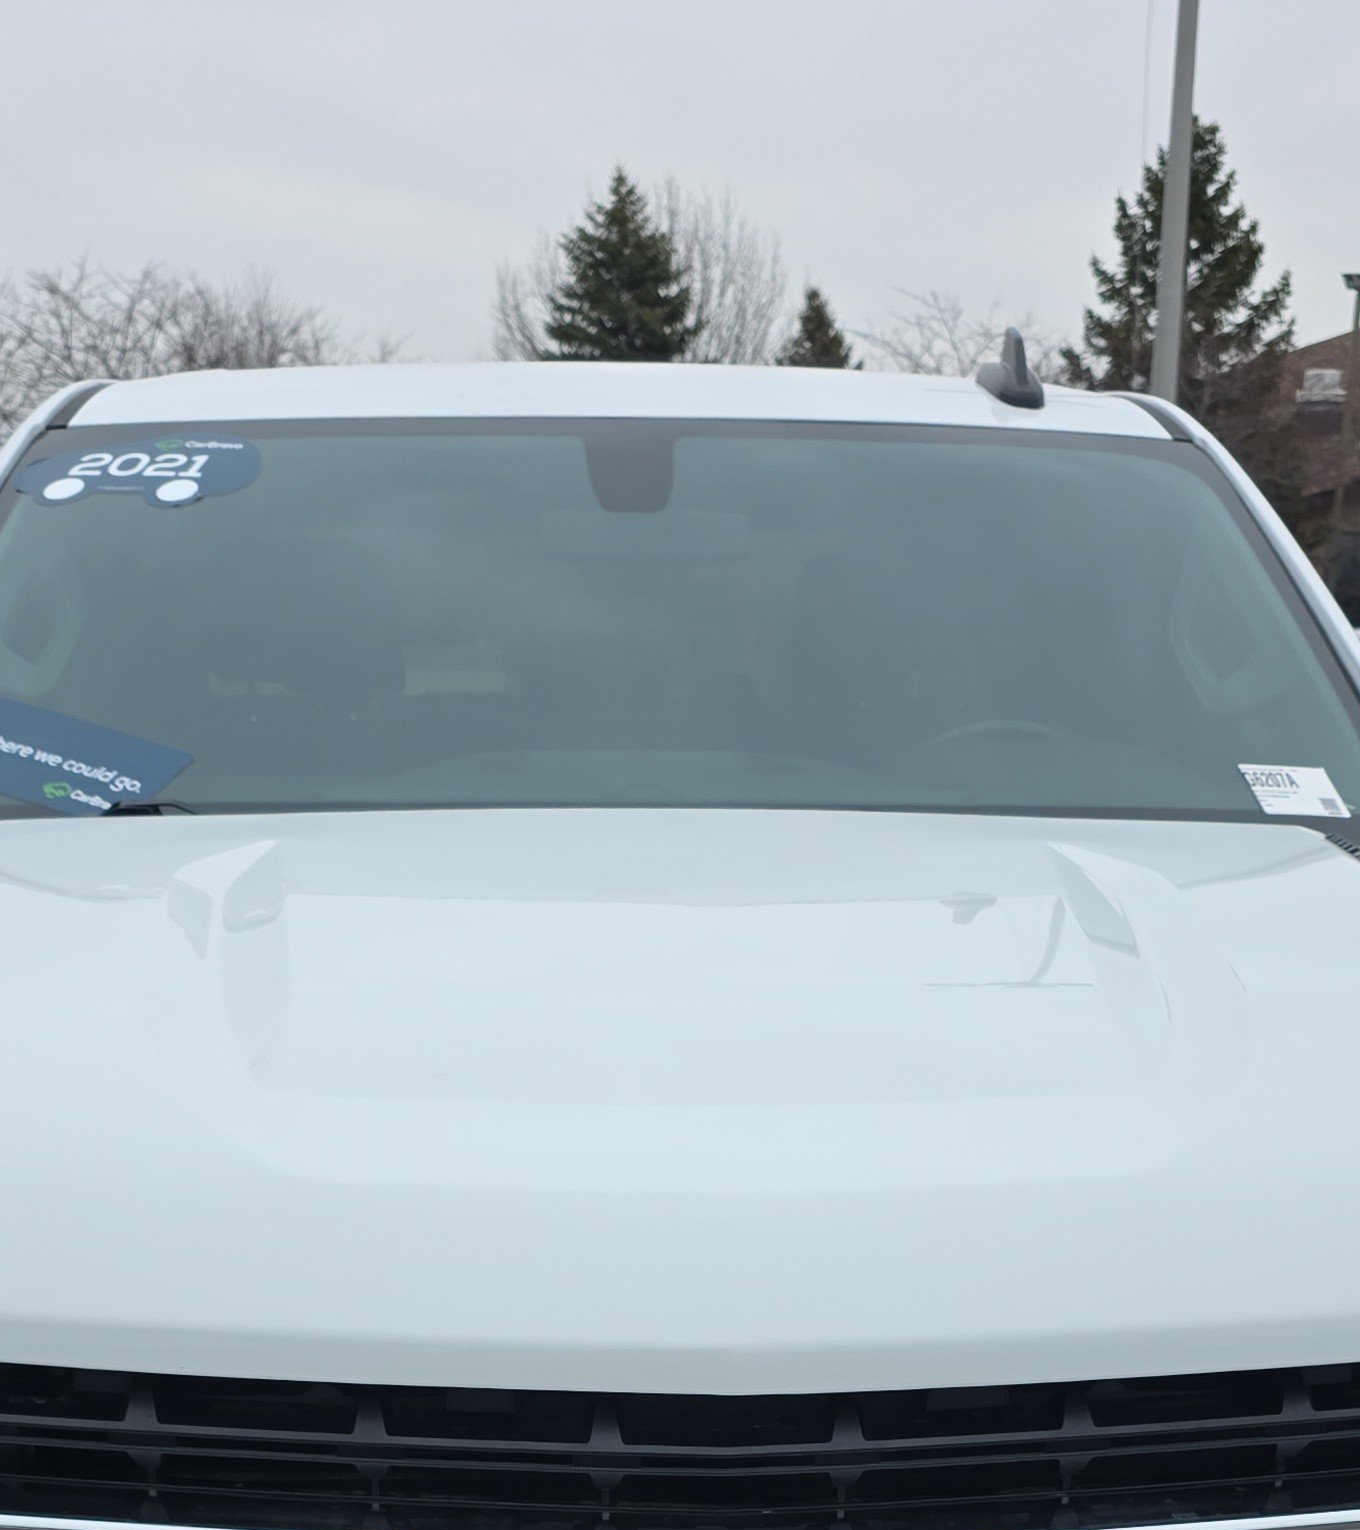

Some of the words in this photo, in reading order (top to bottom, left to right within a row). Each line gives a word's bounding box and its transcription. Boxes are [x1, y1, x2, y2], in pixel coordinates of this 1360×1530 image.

[67, 452, 210, 478] 2021
[33, 749, 63, 767] we
[61, 758, 118, 783] could
